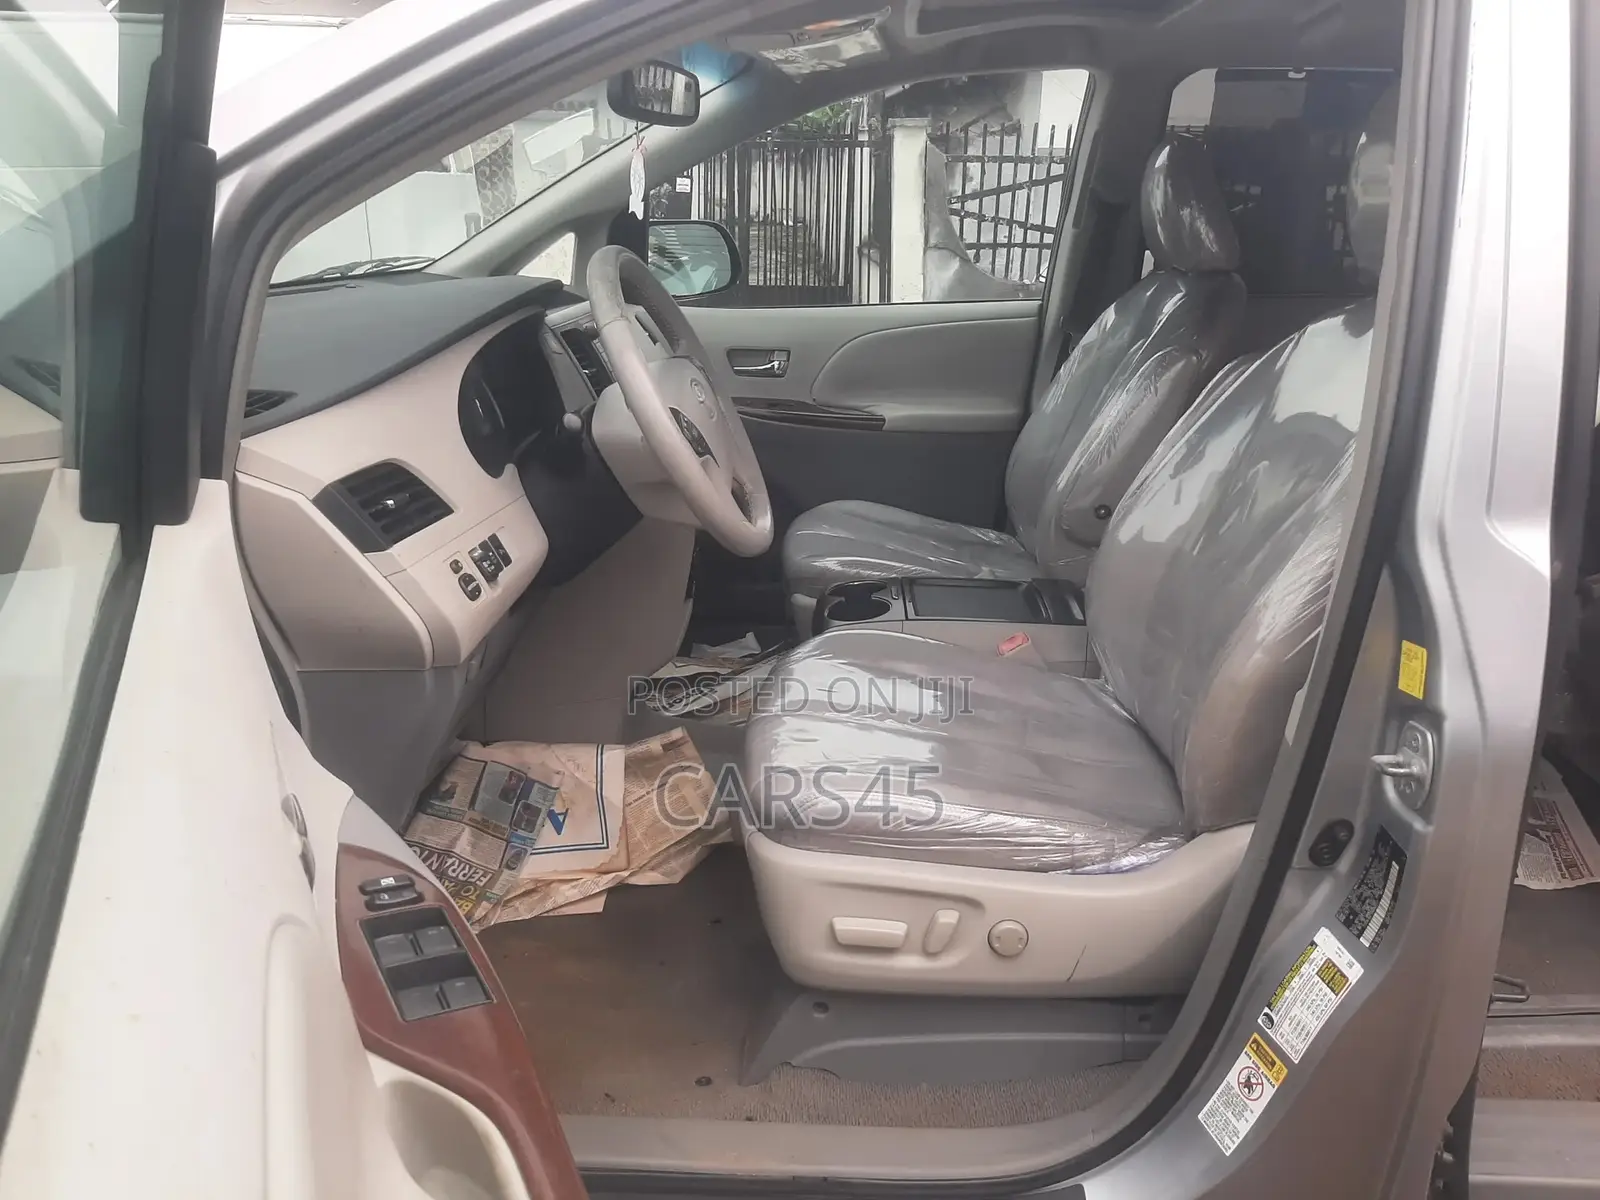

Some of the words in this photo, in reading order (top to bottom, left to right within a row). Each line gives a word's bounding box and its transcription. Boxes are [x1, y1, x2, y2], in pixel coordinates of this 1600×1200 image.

[425, 853, 492, 886] FERRAN
[461, 886, 479, 899] TO
[453, 896, 472, 914] BA
